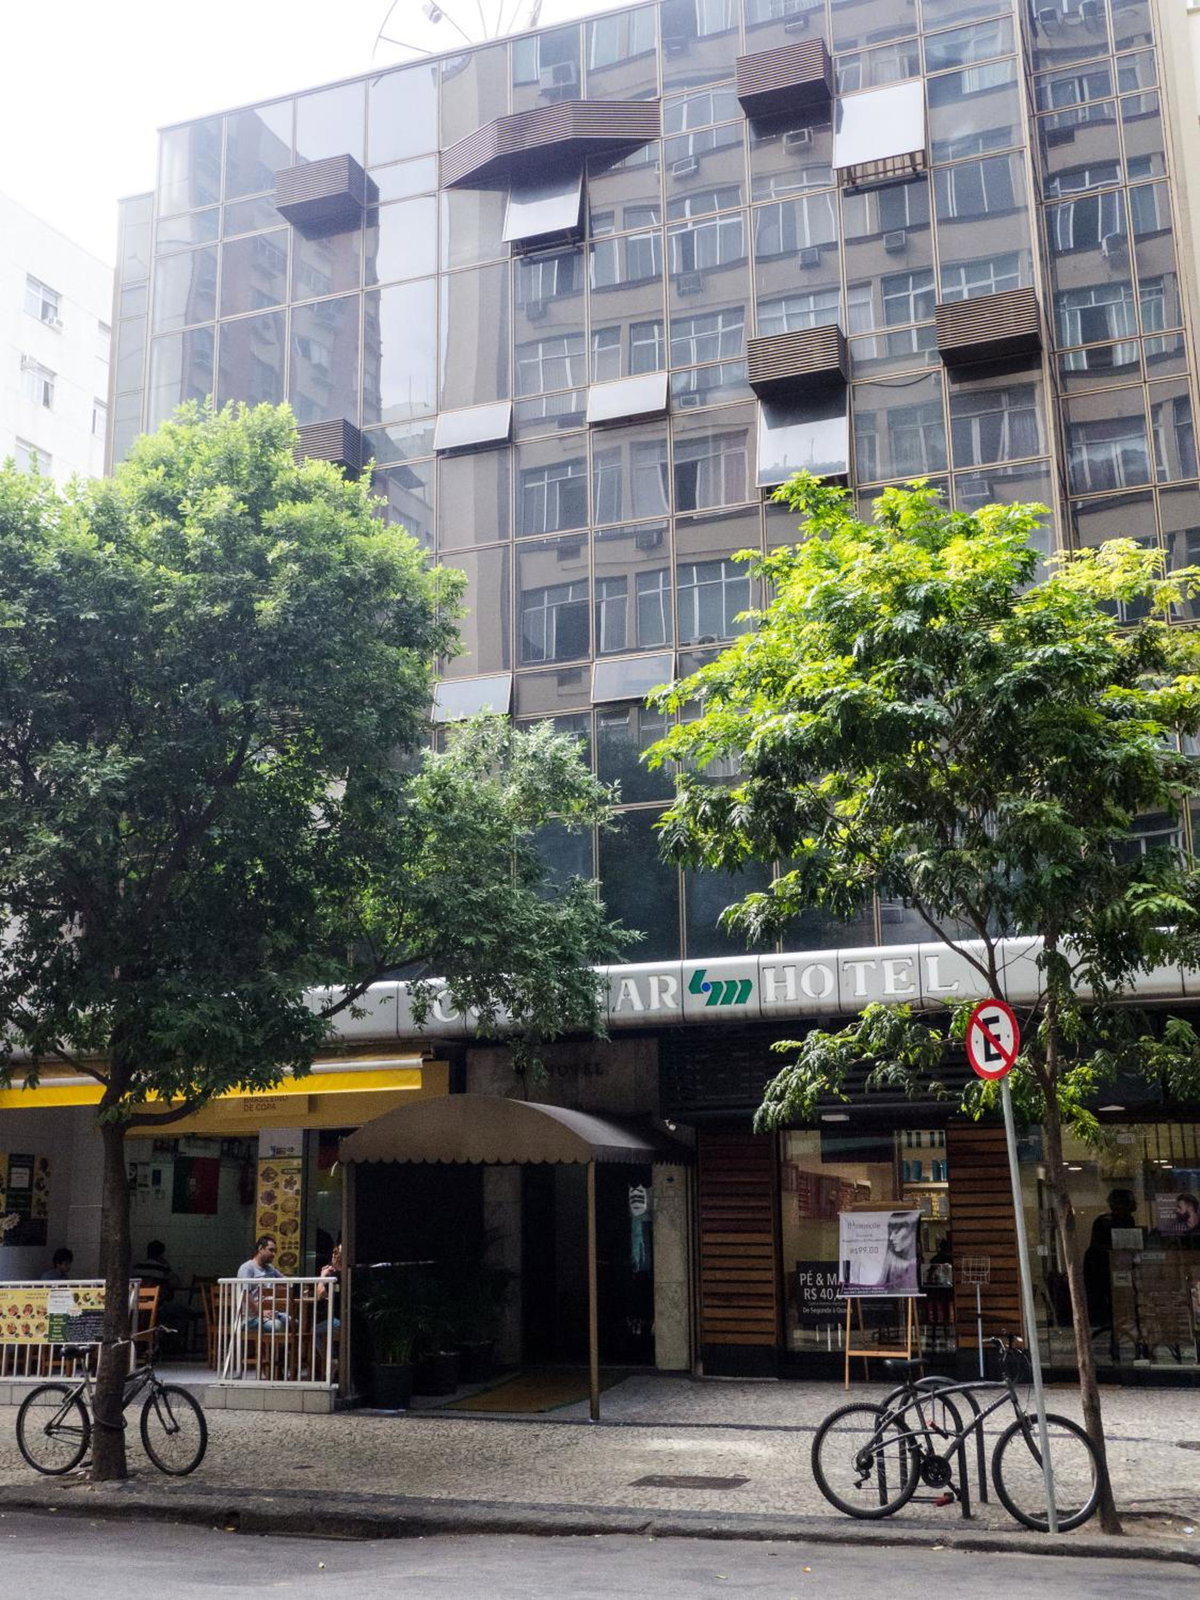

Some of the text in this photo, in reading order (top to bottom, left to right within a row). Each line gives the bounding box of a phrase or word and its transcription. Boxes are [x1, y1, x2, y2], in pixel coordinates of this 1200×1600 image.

[762, 955, 960, 1003] HOTEL
[982, 1015, 1002, 1062] E
[244, 1104, 254, 1112] DE
[799, 1270, 813, 1286] PÉ
[816, 1273, 824, 1286] &
[804, 1287, 818, 1300] R$
